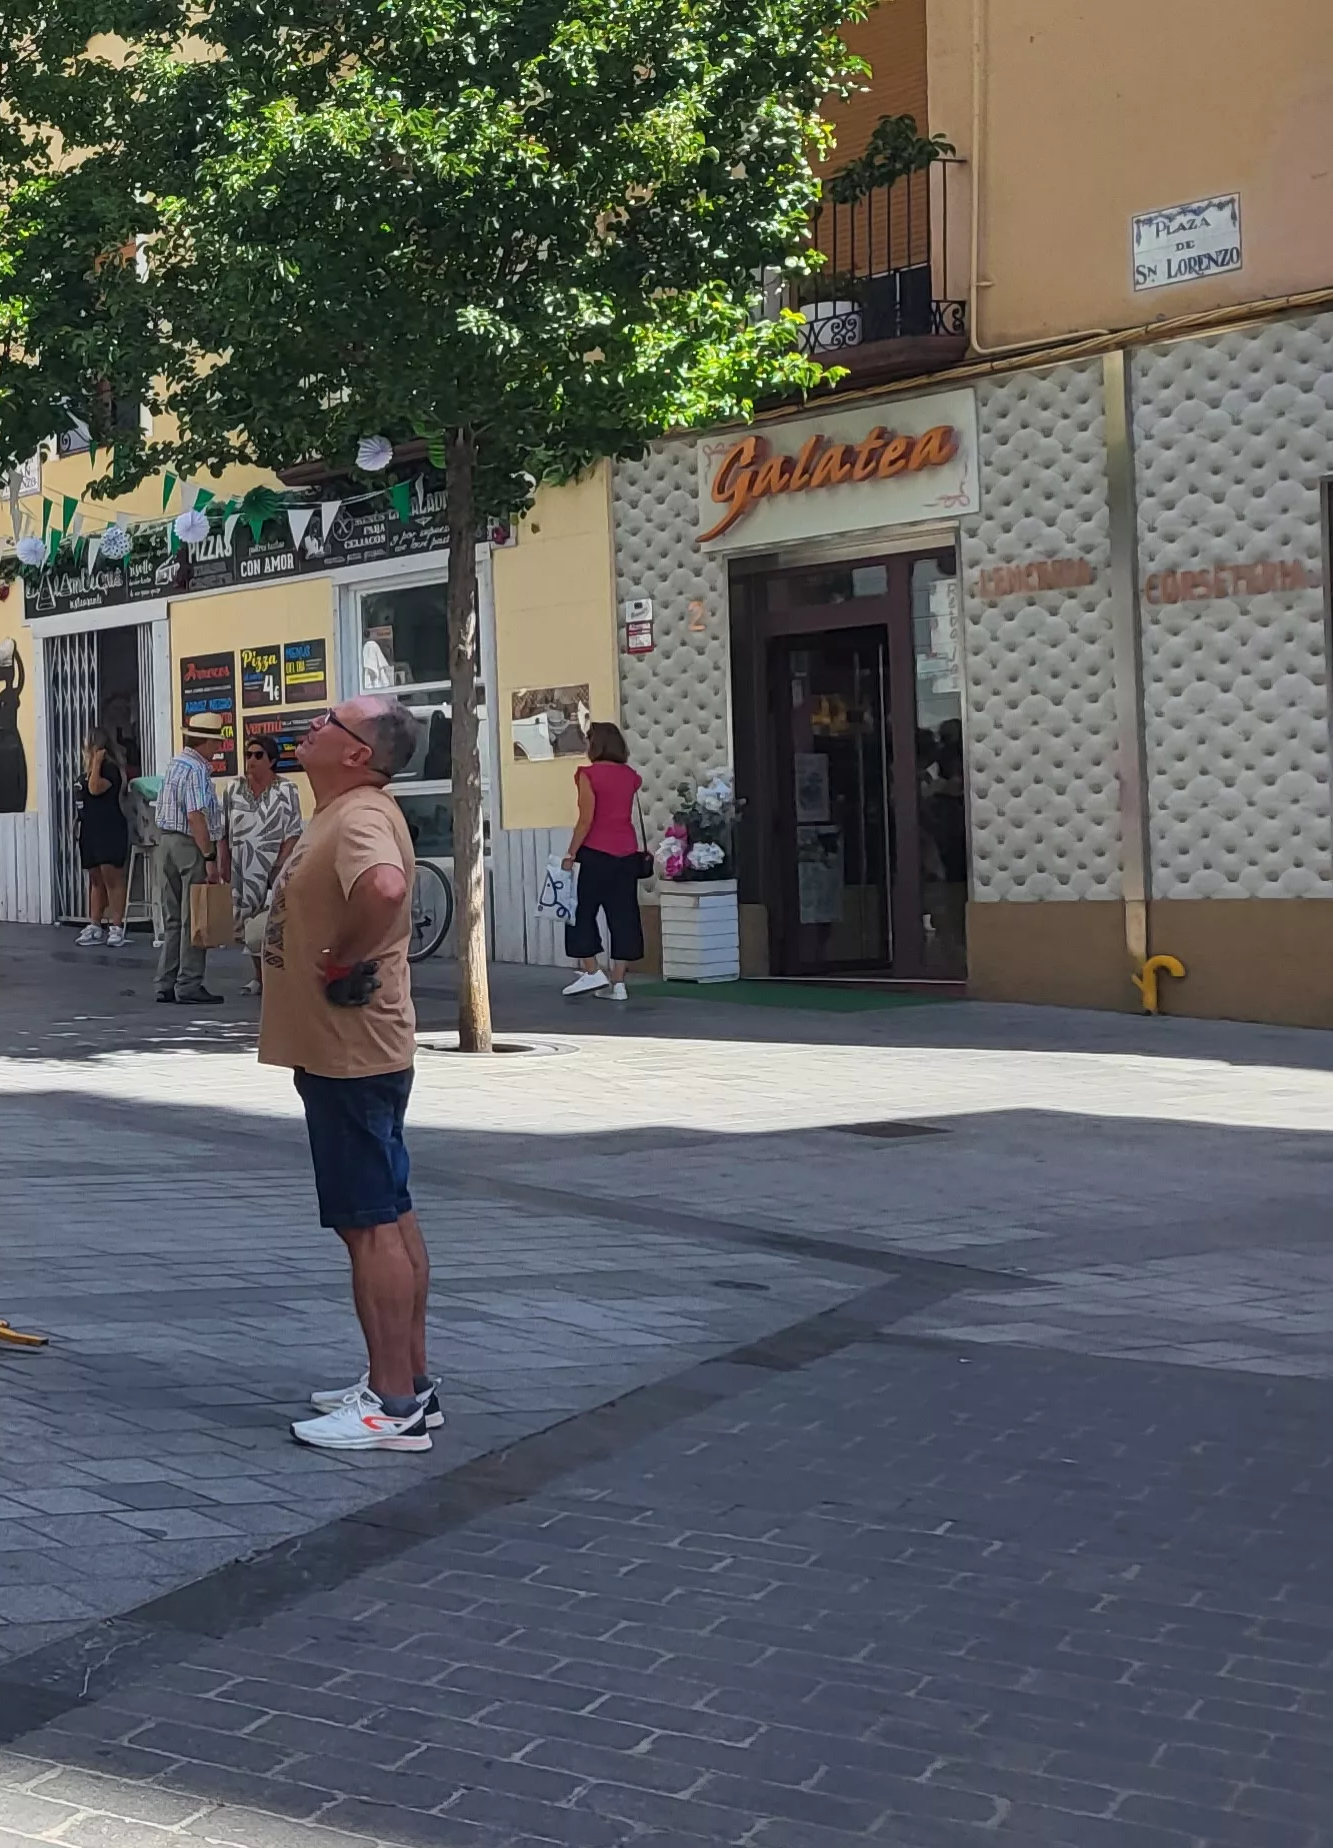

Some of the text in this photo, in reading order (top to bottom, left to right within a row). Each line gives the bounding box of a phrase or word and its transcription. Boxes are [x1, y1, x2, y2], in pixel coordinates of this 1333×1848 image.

[1153, 216, 1211, 238] PLAZA
[1175, 240, 1195, 252] DE
[1166, 246, 1240, 279] LORENZO
[695, 425, 960, 543] Galatea
[188, 534, 233, 564] PIZZAS
[240, 559, 261, 578] CON
[264, 553, 295, 575] AMOR
[687, 600, 706, 632] 2
[241, 650, 278, 673] Pizza
[263, 674, 280, 701] 4€
